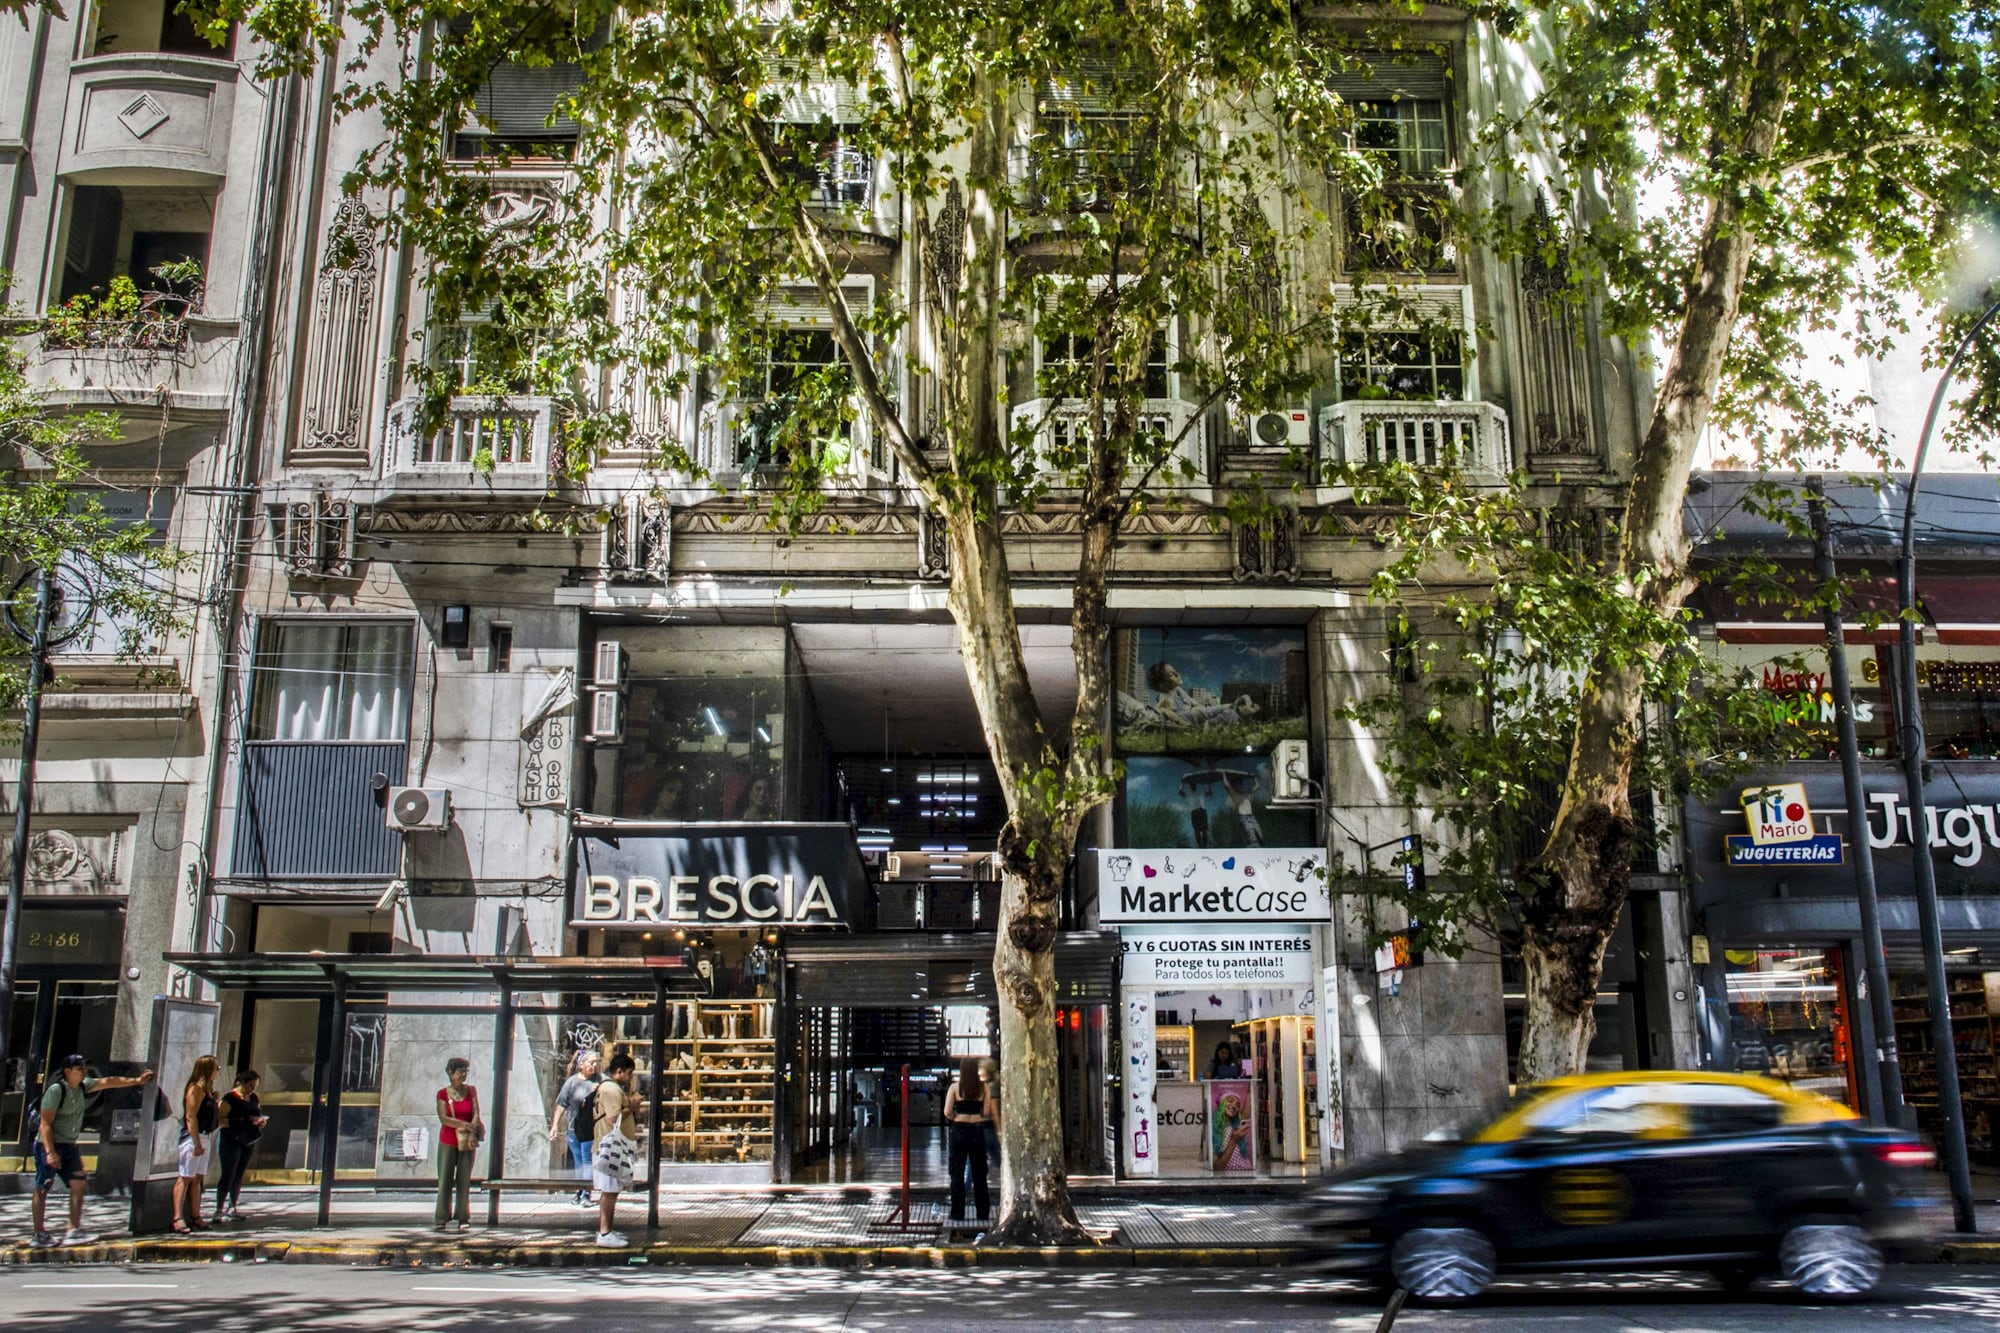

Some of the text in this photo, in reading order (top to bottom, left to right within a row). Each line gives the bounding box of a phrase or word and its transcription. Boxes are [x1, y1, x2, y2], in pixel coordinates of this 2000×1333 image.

[1762, 664, 1826, 699] Merry
[545, 760, 561, 800] ORO
[1761, 822, 1807, 839] Mario
[1734, 844, 1836, 861] JUGUETERÍAS
[584, 874, 838, 921] BRESCIA
[1120, 884, 1307, 913] MarketCase
[29, 932, 80, 947] 2436
[1134, 941, 1143, 951] Y
[1146, 941, 1155, 952] 6
[1159, 940, 1217, 952] CUOTAS
[1220, 939, 1246, 951] SIN
[1250, 936, 1311, 951] INTERÉS
[1155, 957, 1283, 970] Protege tu pantalla!!
[1155, 967, 1285, 979] Para todos los teléfonos
